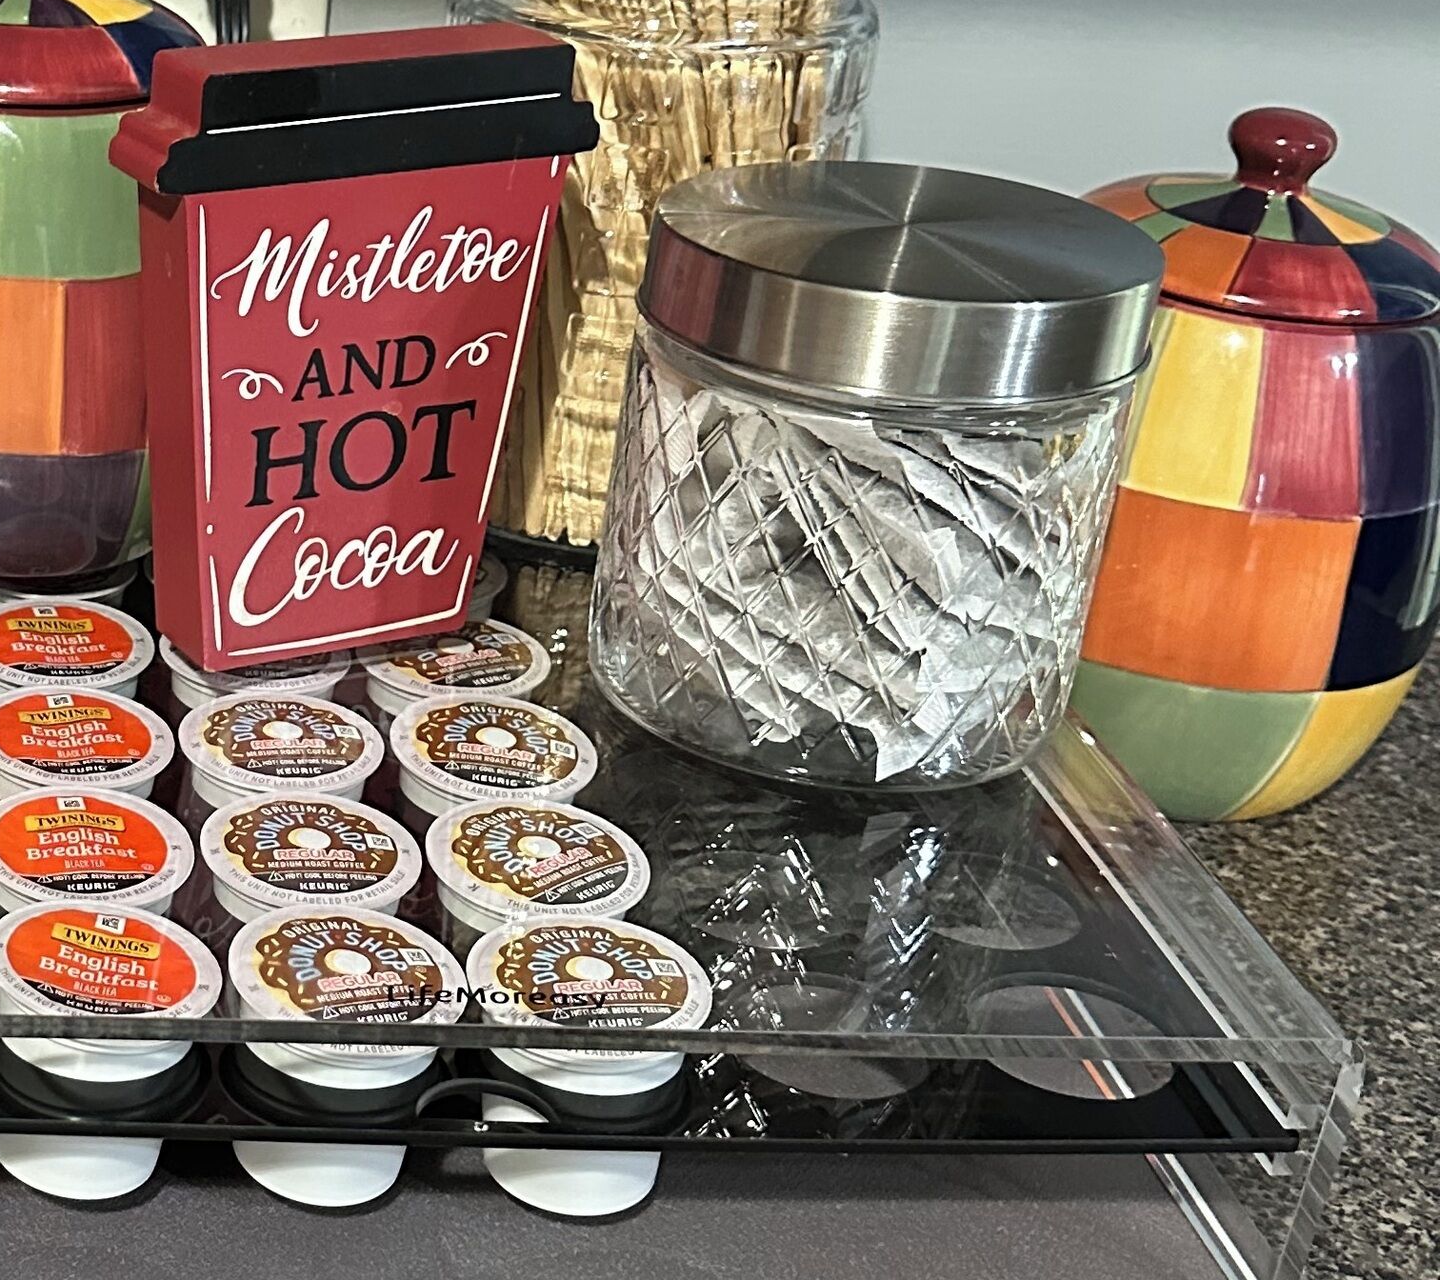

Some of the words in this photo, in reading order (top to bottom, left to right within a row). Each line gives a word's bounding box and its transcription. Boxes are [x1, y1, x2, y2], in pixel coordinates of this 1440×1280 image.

[211, 205, 531, 336] Mistletoe
[292, 335, 436, 401] AND
[244, 400, 476, 507] HOT
[229, 507, 459, 627] Cocoa
[20, 631, 92, 645] English
[10, 642, 107, 655] Breakfast
[28, 708, 106, 722] TWININGS
[234, 702, 307, 712] ORIGINAL
[459, 705, 532, 722] ORIGINAL
[30, 721, 108, 738] English
[231, 709, 278, 743] DONUT
[286, 710, 336, 741] SHOP
[443, 712, 500, 743] DONUT
[506, 718, 549, 755] SHOP
[21, 733, 125, 748] Breakfast
[250, 738, 327, 749] REGULAR
[457, 742, 537, 762] REGULAR
[471, 773, 522, 787] KEURIG
[262, 804, 337, 817] ORIGINAL
[37, 813, 120, 827] TWININGS
[465, 809, 531, 836] ORIGINAL
[37, 828, 120, 846] English
[252, 812, 306, 850] DONUT
[314, 815, 367, 852] SHOP
[521, 819, 588, 846] SHOP
[25, 844, 138, 860] Breakfast
[273, 847, 356, 861] REGULAR
[268, 860, 303, 869] MEDIUM
[304, 861, 331, 869] ROAST
[333, 861, 366, 869] COFFEE
[528, 847, 594, 878] REGULAR
[67, 882, 119, 891] KEURIG
[271, 890, 292, 900] NOT
[299, 882, 351, 891] KEURIG
[575, 880, 616, 901] KEURIG
[533, 905, 559, 914] UNIT
[562, 906, 583, 914] NOT
[282, 921, 363, 939] ORIGINAL
[529, 929, 614, 944] ORIGINAL
[63, 926, 151, 953] TWININGS
[57, 944, 146, 976] English
[287, 930, 336, 982] DONUT
[343, 932, 409, 972] SHOP
[527, 939, 582, 985] DONUT
[591, 941, 654, 980] SHOP
[38, 956, 159, 991] Breakfast
[317, 972, 403, 991] REGULAR
[553, 979, 644, 995] REGULAR
[620, 992, 657, 1001] COFFEE
